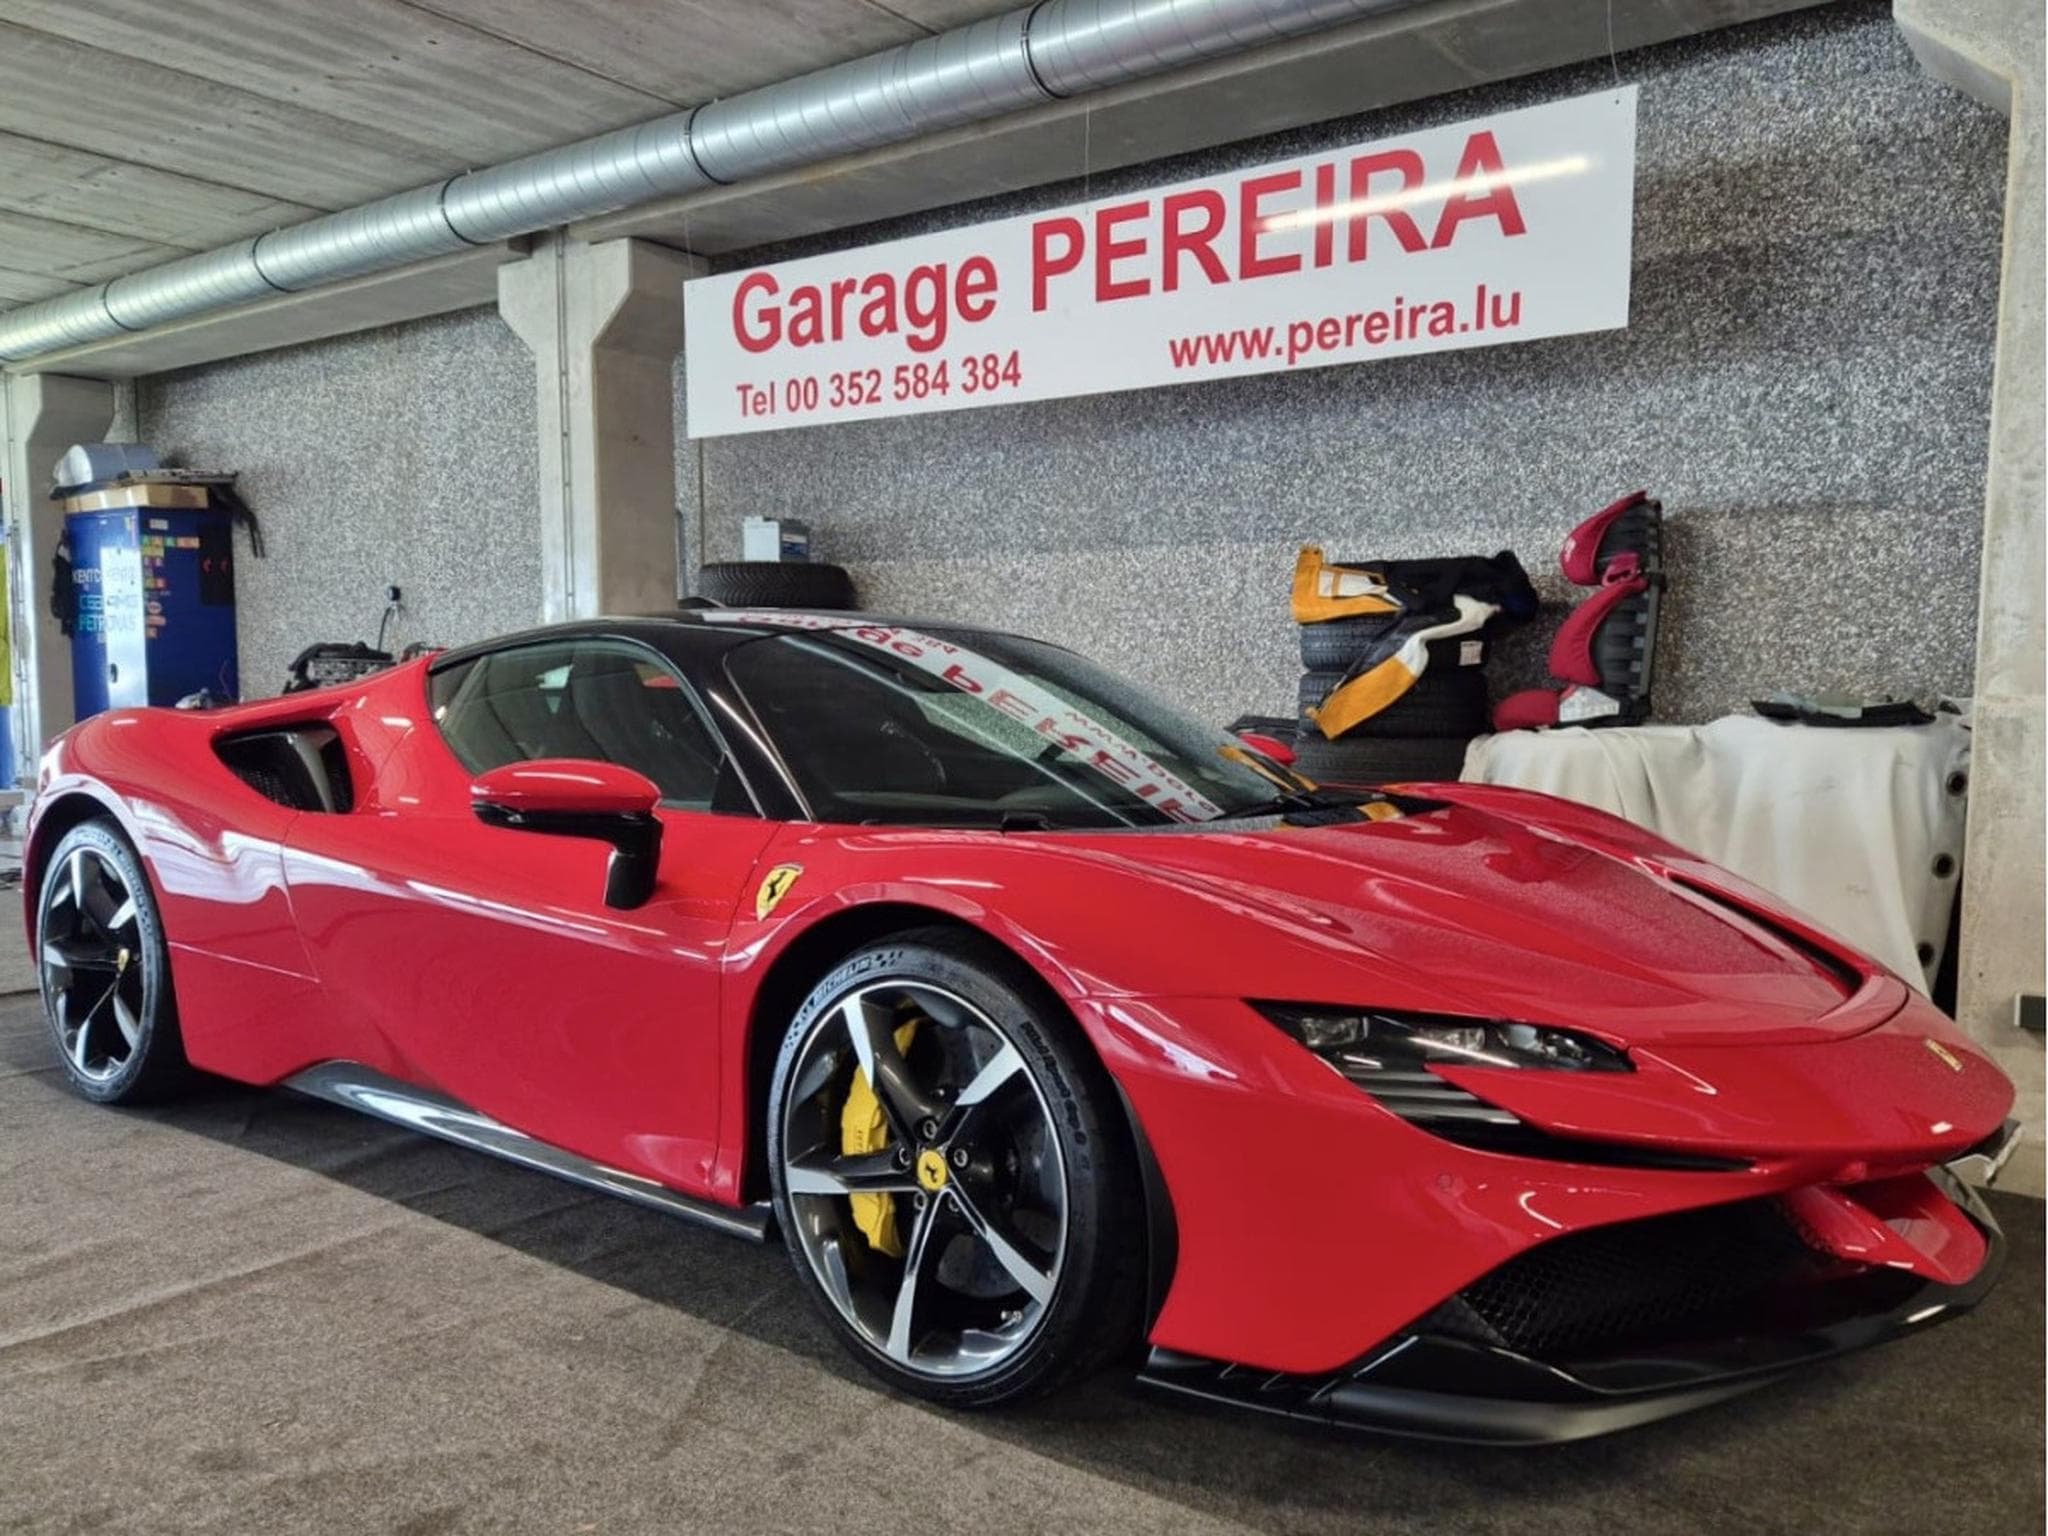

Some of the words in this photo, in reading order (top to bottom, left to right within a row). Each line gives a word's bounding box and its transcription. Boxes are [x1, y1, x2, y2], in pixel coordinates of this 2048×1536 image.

[732, 264, 999, 354] Garage
[1031, 131, 1527, 313] PEREIRA
[1169, 285, 1522, 367] www.pereira.lu
[736, 382, 776, 418] Tel
[785, 379, 819, 412] 00
[829, 370, 882, 408] 352
[893, 361, 950, 402] 584
[962, 350, 1022, 395] 384
